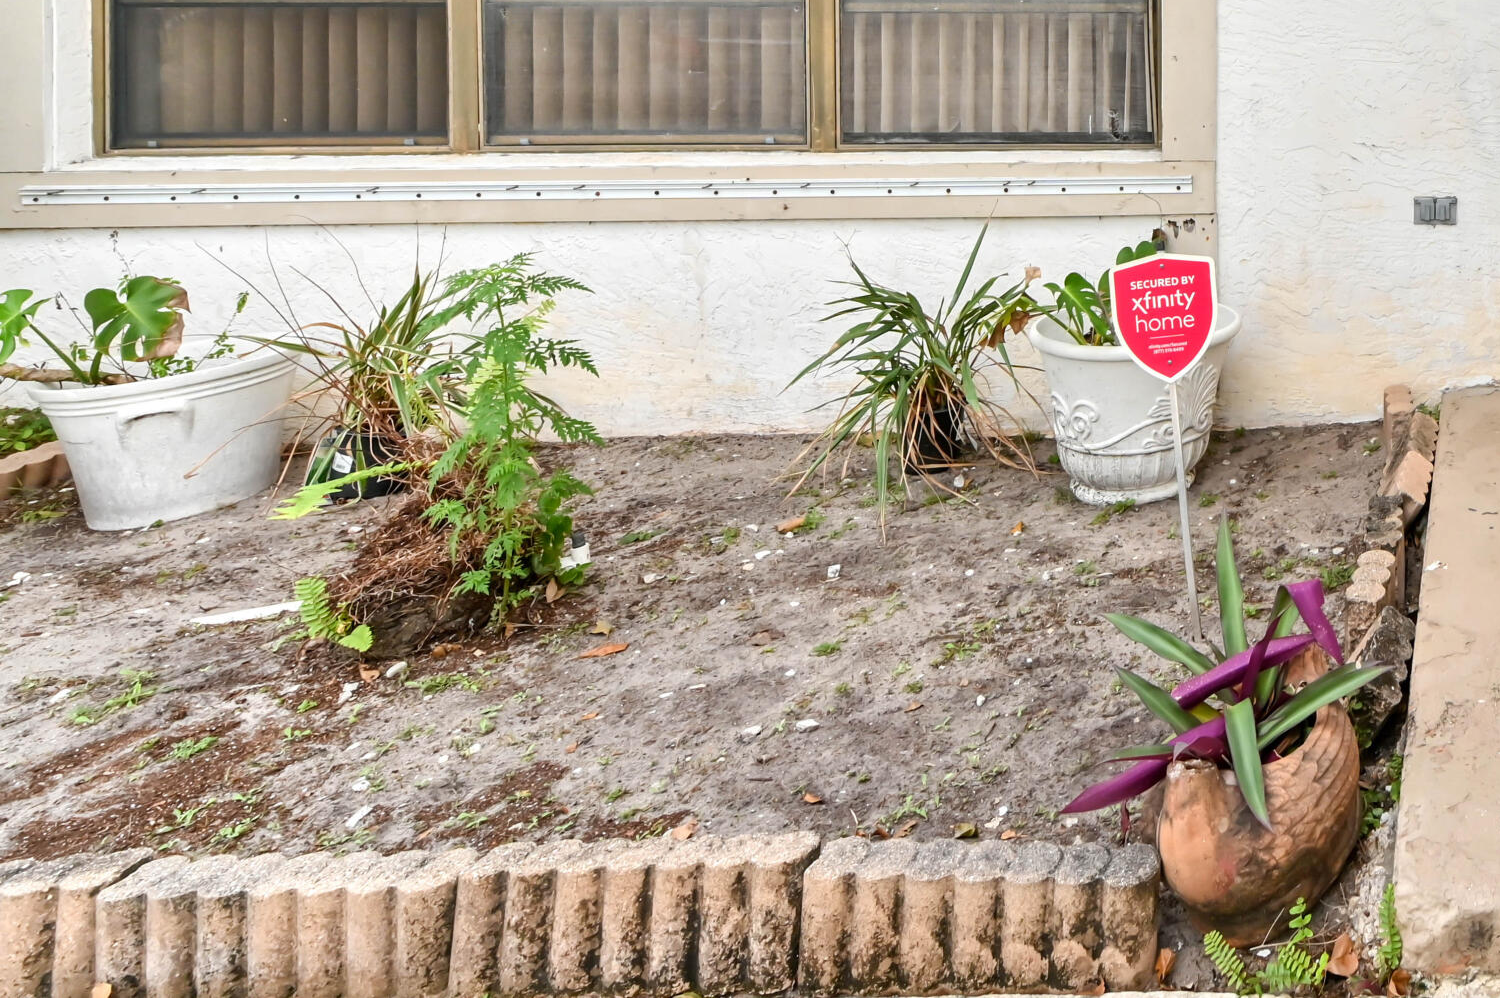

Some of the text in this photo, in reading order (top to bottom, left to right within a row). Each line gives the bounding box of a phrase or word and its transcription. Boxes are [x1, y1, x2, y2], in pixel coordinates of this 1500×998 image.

[1130, 274, 1195, 290] SECURED BY
[1131, 289, 1195, 314] xfinity
[1135, 314, 1195, 333] home
